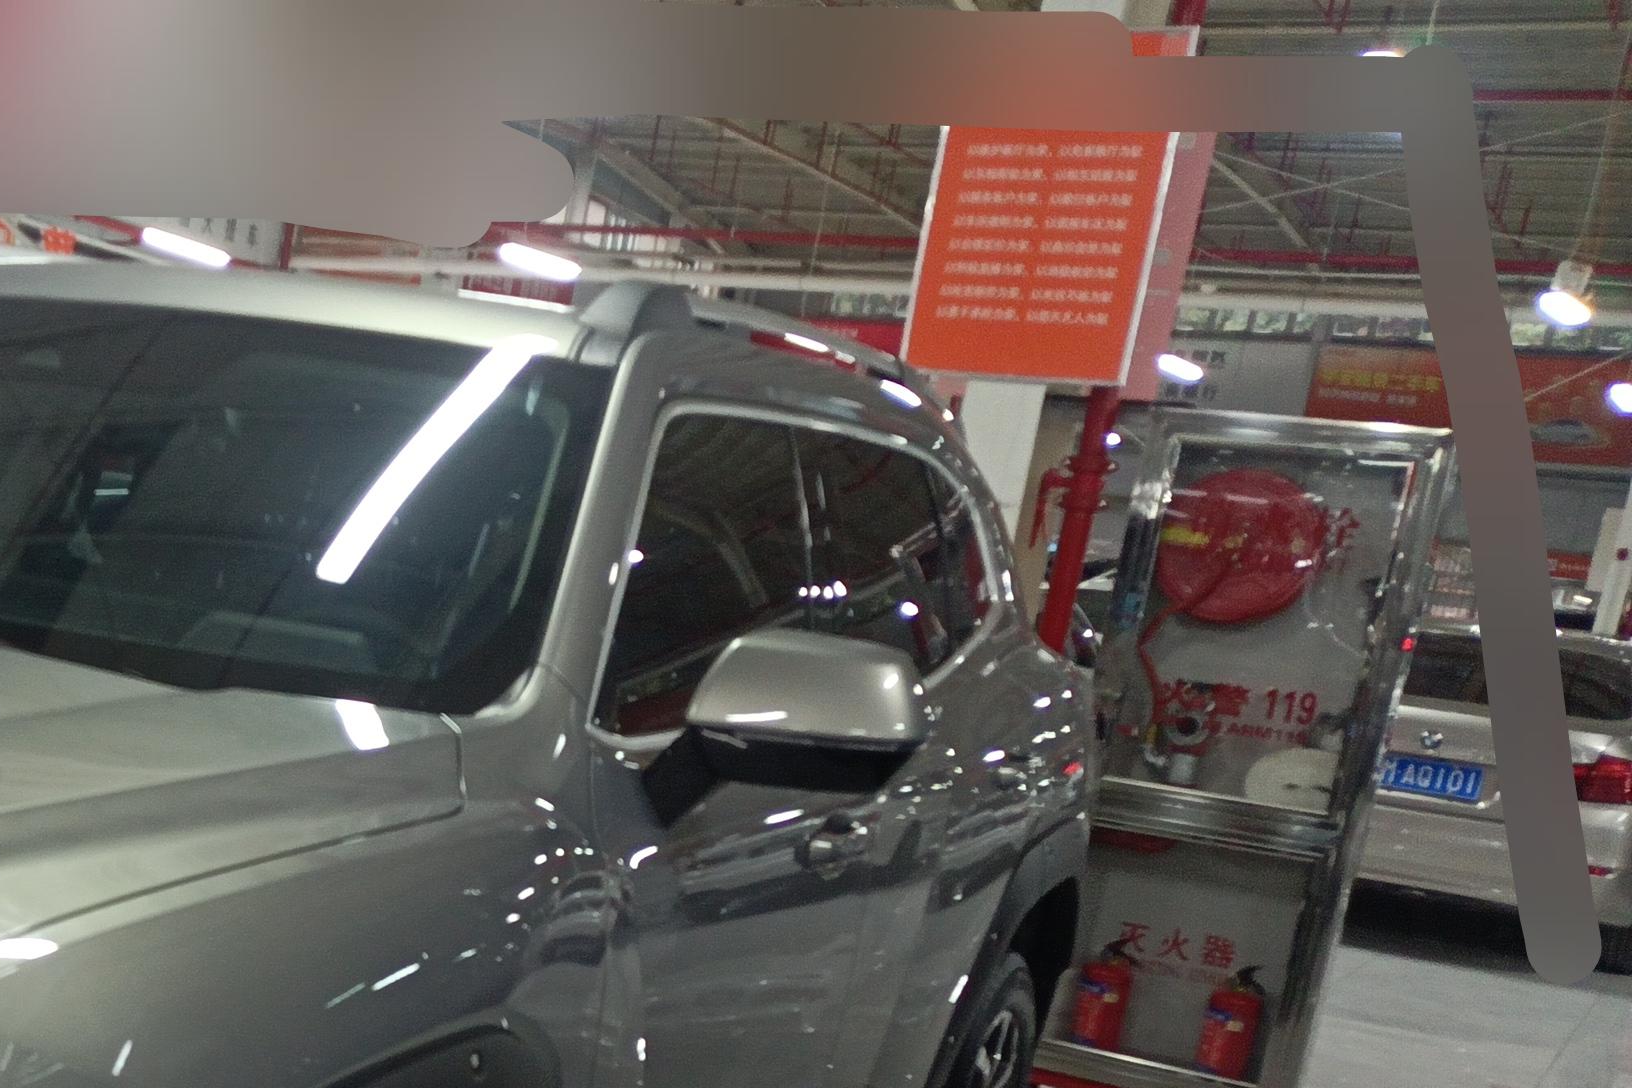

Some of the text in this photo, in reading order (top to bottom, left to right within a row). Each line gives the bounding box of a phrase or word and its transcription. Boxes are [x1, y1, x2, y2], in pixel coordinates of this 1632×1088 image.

[1265, 688, 1318, 726] 119
[1120, 920, 1235, 968] 灭火器
